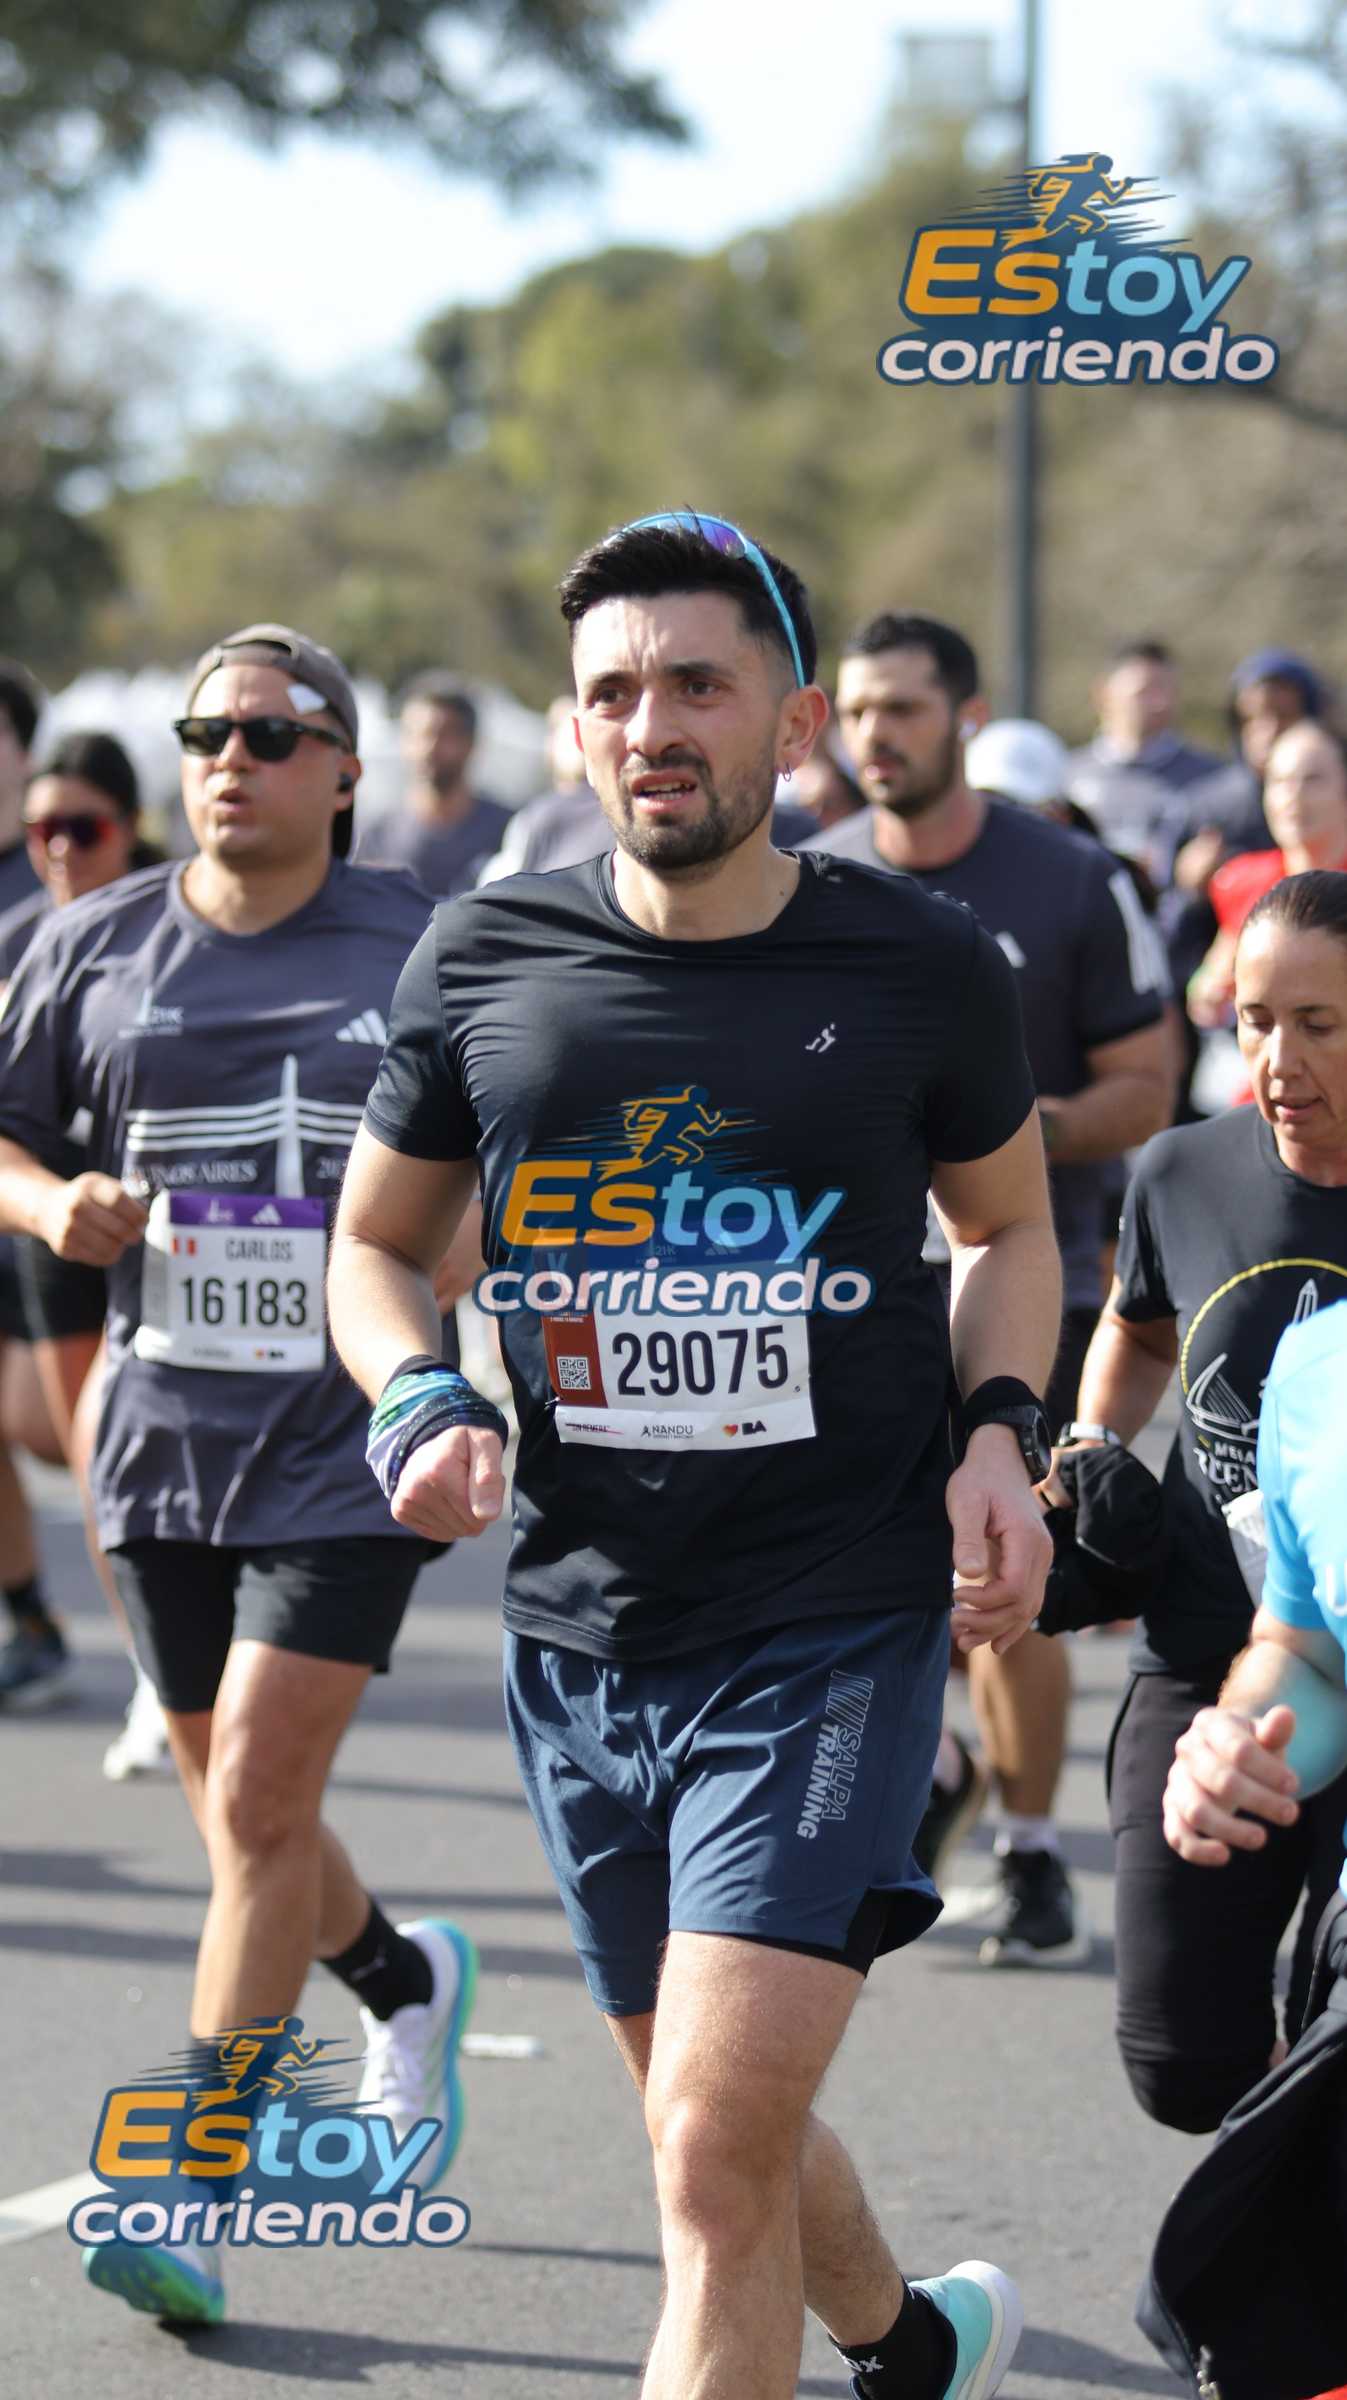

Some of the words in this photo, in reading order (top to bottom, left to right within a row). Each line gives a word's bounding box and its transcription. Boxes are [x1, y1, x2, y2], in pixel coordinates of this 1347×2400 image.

[226, 1237, 293, 1261] CARLOS
[181, 1277, 308, 1326] 16183
[611, 1325, 789, 1397] 29075
[742, 1420, 767, 1435] BA
[796, 1723, 839, 1839] TRAINING
[821, 1727, 862, 1821] SALPA
